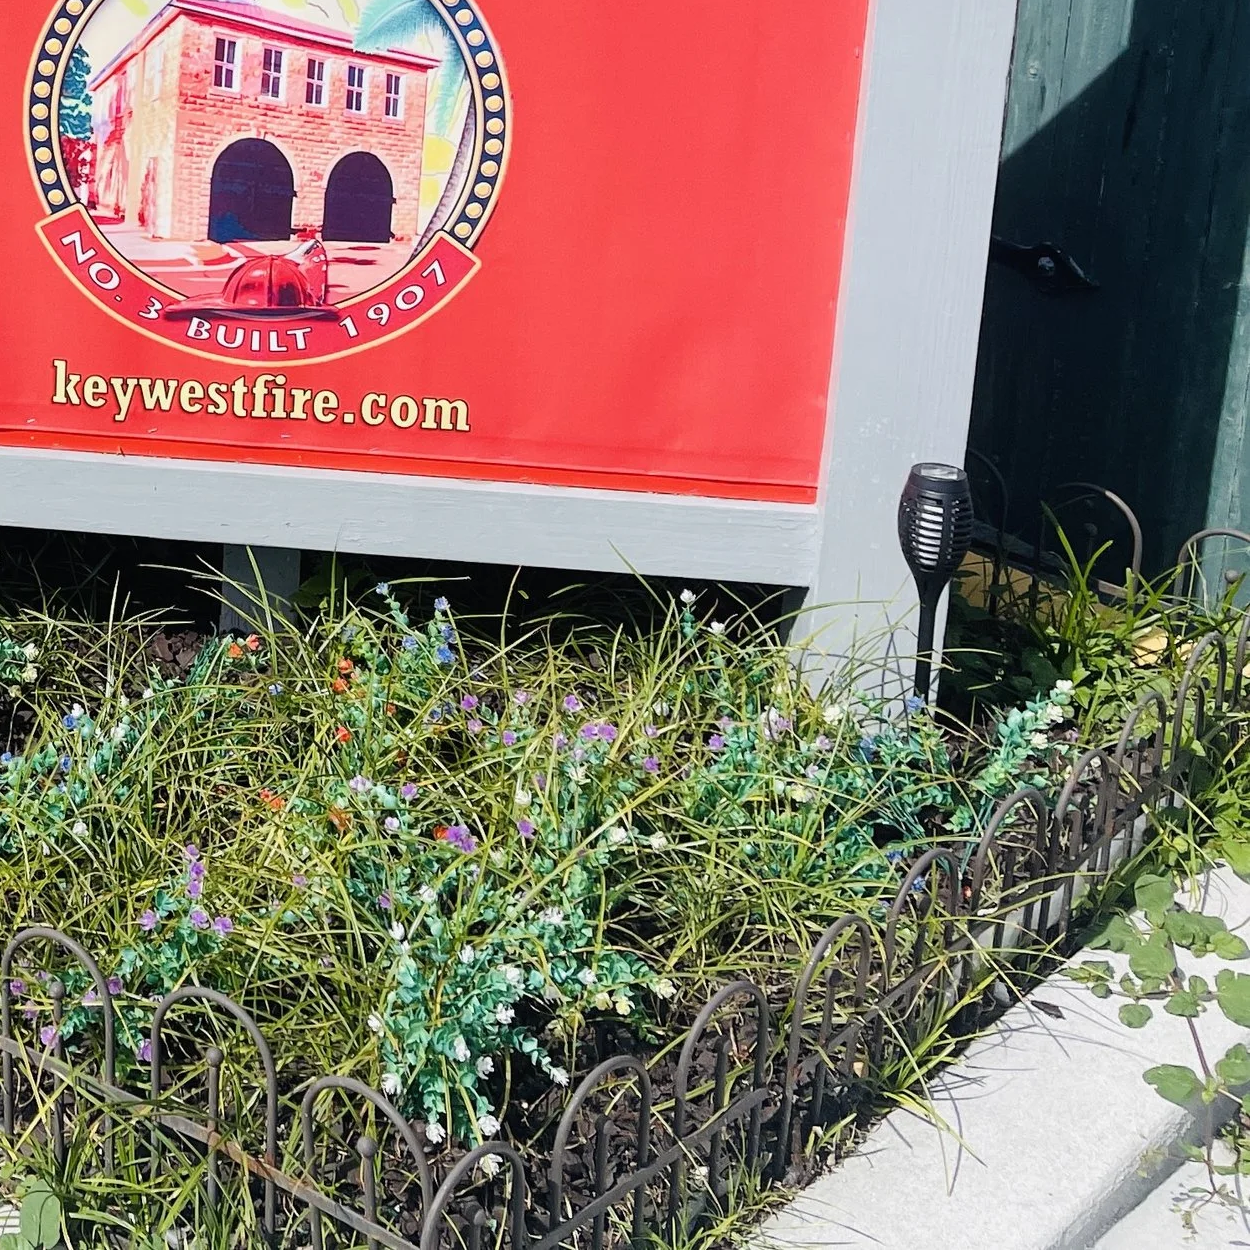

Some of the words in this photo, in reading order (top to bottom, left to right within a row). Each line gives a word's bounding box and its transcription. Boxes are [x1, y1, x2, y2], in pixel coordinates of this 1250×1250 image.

[61, 230, 122, 303] NO.
[138, 297, 164, 321] 3
[187, 317, 313, 352] BUILT
[339, 259, 447, 339] 1907
[51, 359, 471, 432] keywestfire.com
